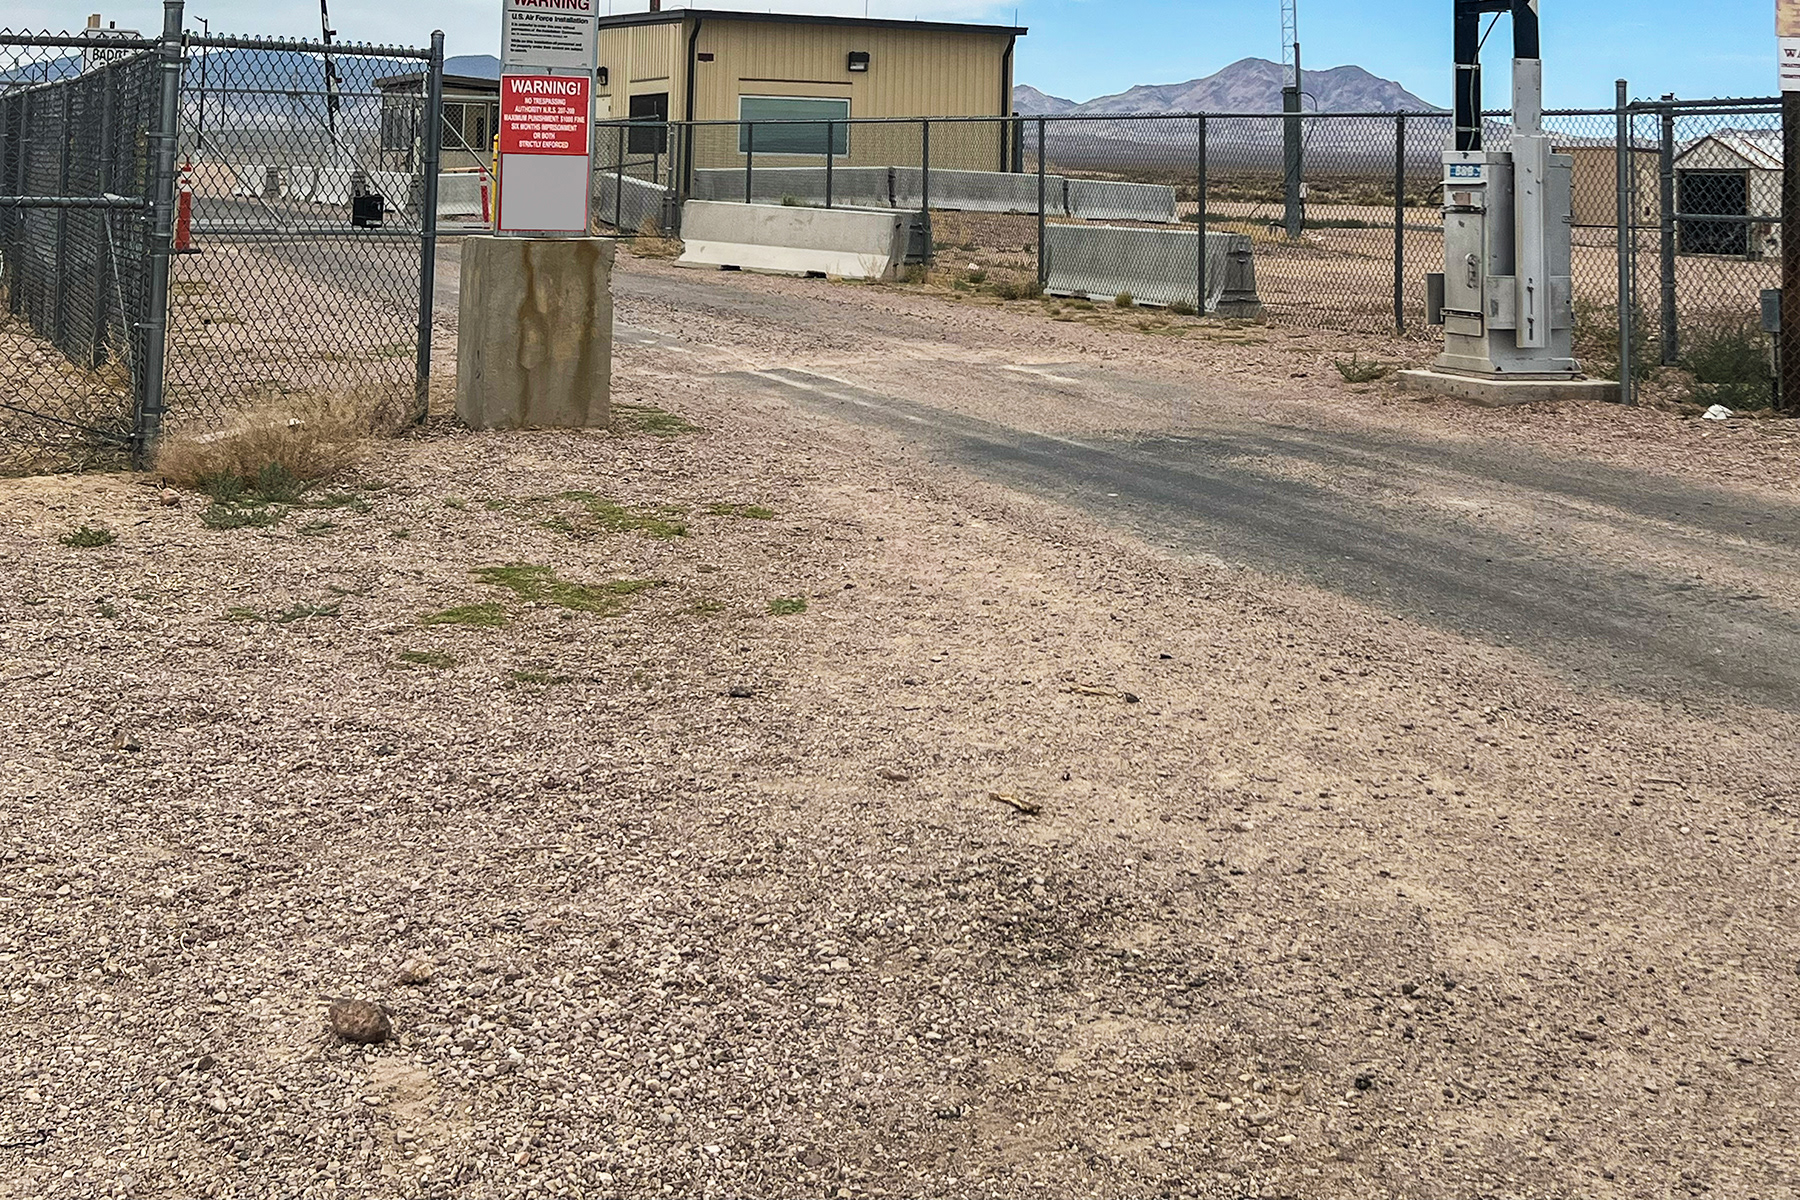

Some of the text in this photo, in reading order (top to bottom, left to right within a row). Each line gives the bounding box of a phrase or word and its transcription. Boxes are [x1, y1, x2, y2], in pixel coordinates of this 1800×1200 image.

[554, 16, 589, 24] Installation
[1784, 48, 1800, 59] W
[510, 79, 581, 96] WARNING!
[533, 97, 566, 105] TRESPASSING
[574, 116, 585, 124] FINE
[511, 122, 578, 132] SIX MONTHS IMPRISONMENT
[541, 132, 556, 140] BOTH
[518, 140, 569, 149] STRICTLY ENFORCED
